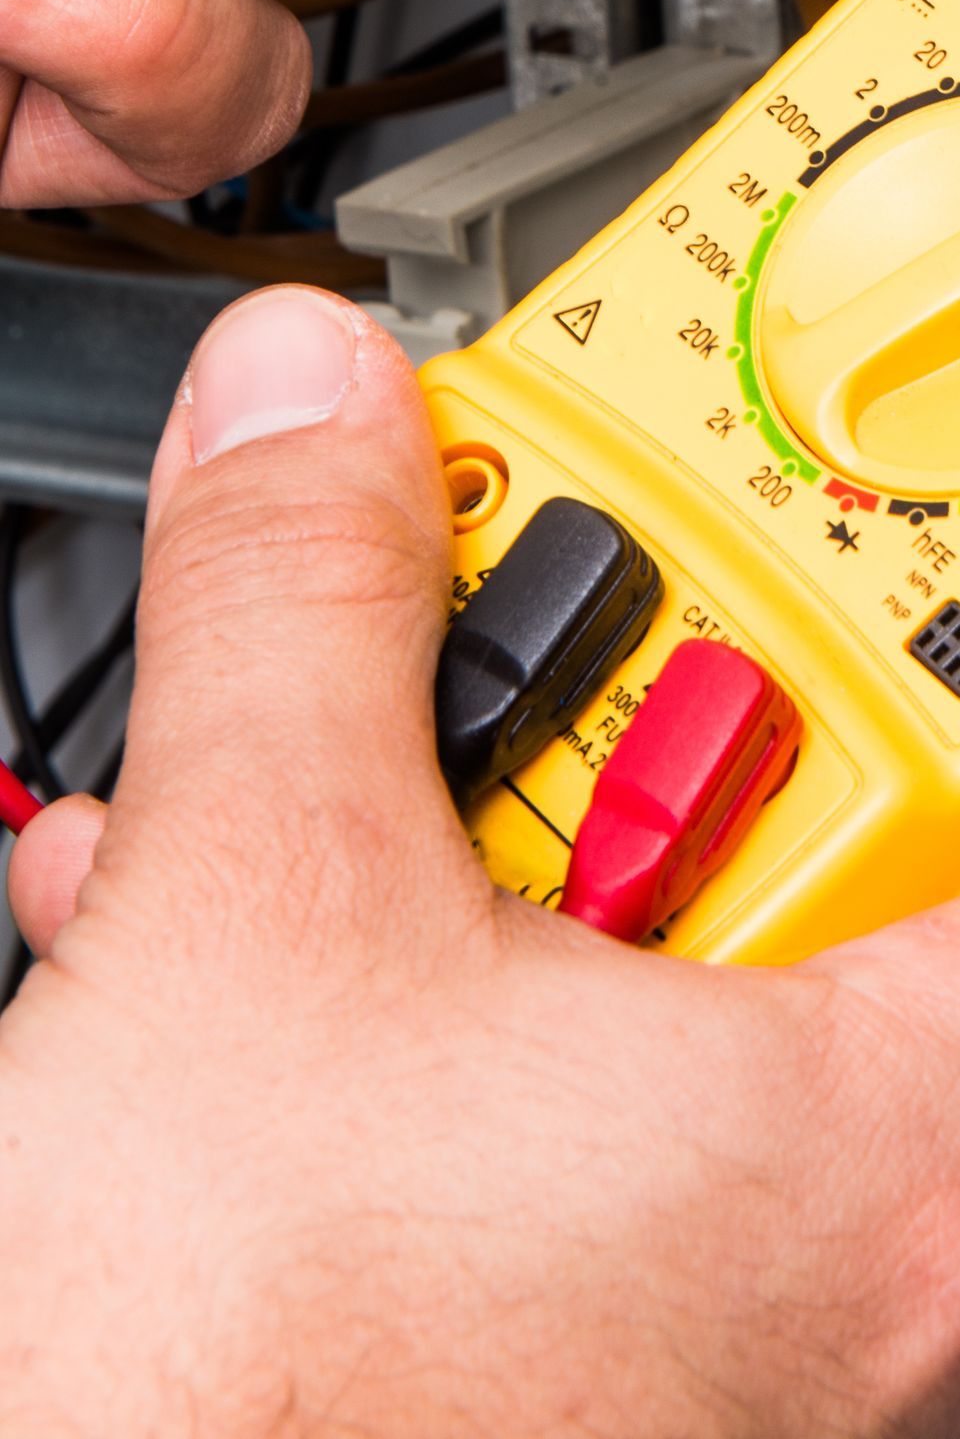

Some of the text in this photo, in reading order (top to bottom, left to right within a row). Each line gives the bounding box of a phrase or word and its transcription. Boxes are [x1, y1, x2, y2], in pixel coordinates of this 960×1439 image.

[913, 40, 948, 70] 20
[855, 78, 879, 100] 2
[765, 95, 822, 149] 200m
[727, 172, 769, 208] 2M
[657, 204, 690, 234] Ω
[685, 234, 736, 284] 200k
[678, 318, 721, 360] 20k
[704, 406, 737, 440] 2k
[748, 466, 792, 508] 200
[912, 528, 957, 574] hFE
[905, 569, 937, 600] NPN
[683, 605, 720, 640] CAT
[881, 594, 912, 621] PNP
[596, 716, 625, 743] FU
